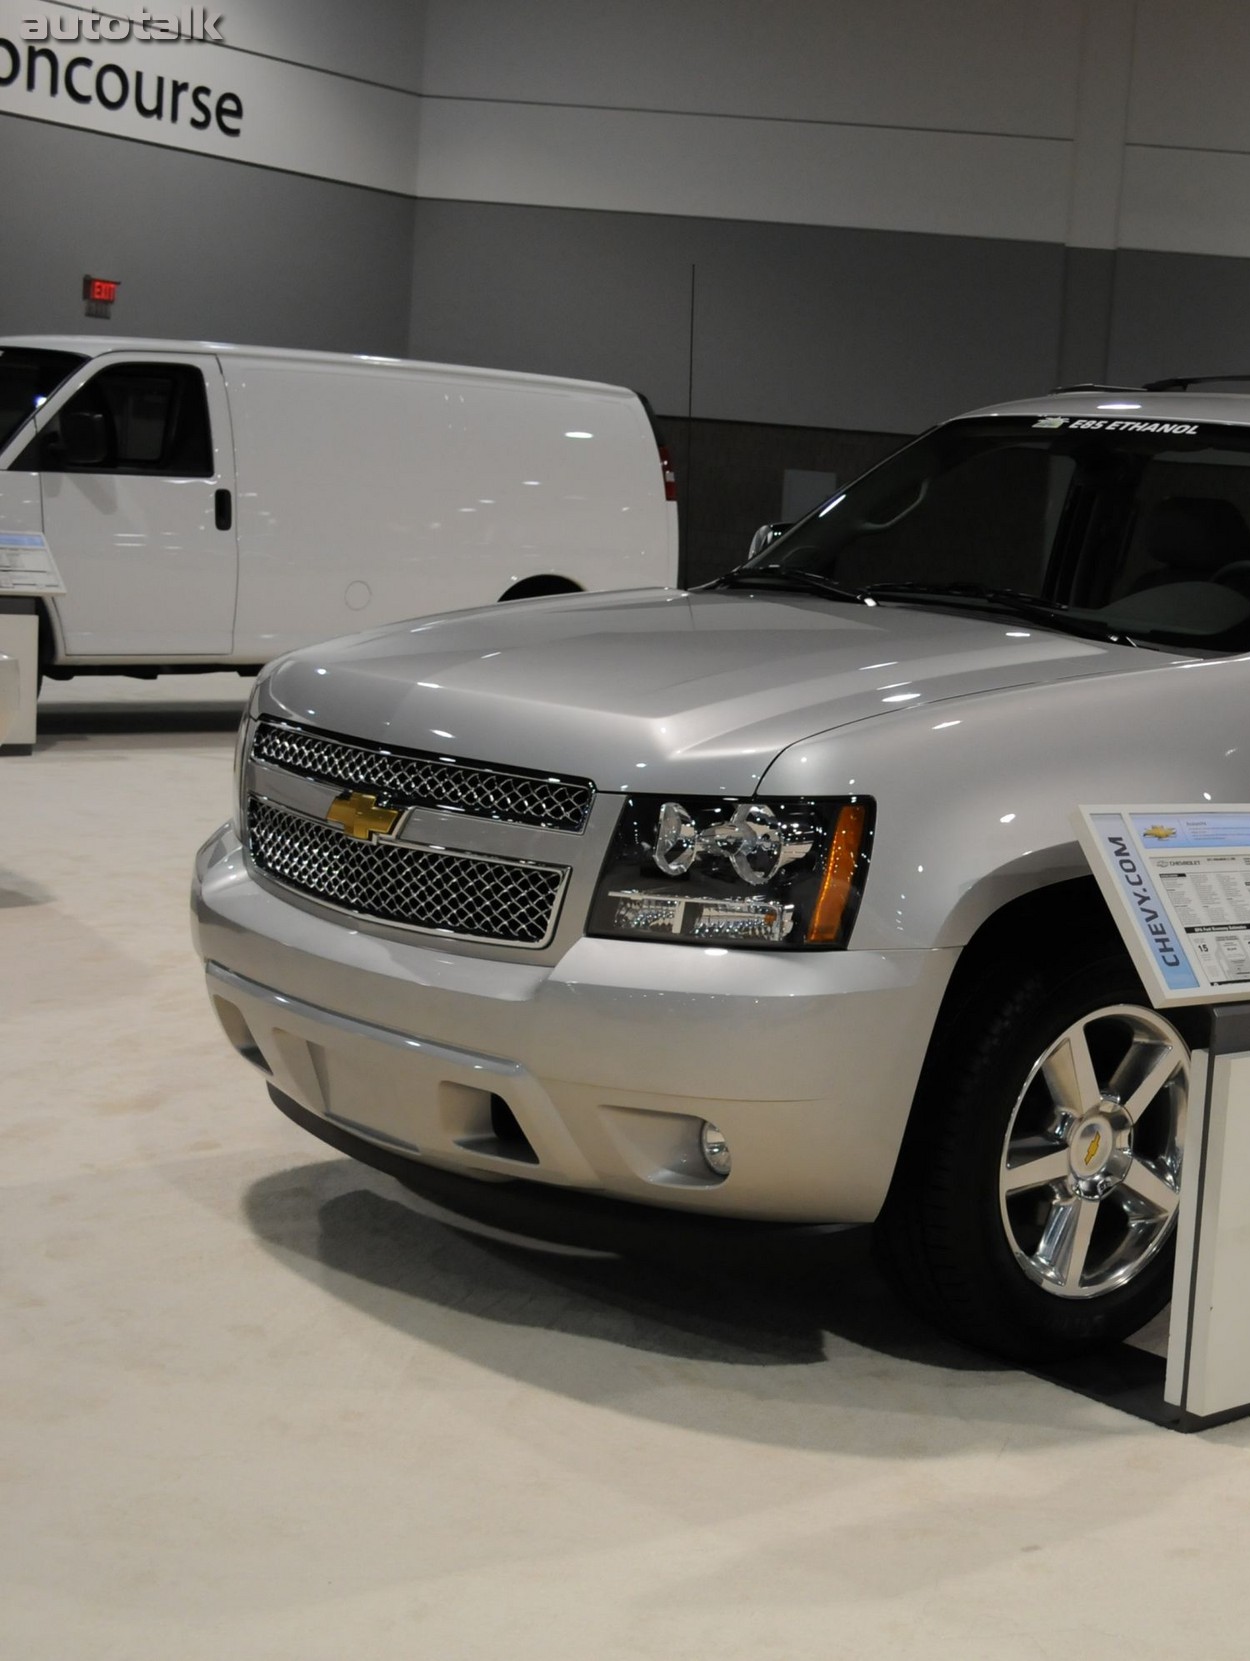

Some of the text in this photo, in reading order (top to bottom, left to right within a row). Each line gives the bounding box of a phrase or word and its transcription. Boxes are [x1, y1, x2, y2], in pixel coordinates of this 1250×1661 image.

[1069, 419, 1199, 435] E85 ETHANOL
[1108, 836, 1180, 967] CHEVY.COM
[1198, 944, 1209, 952] 15
